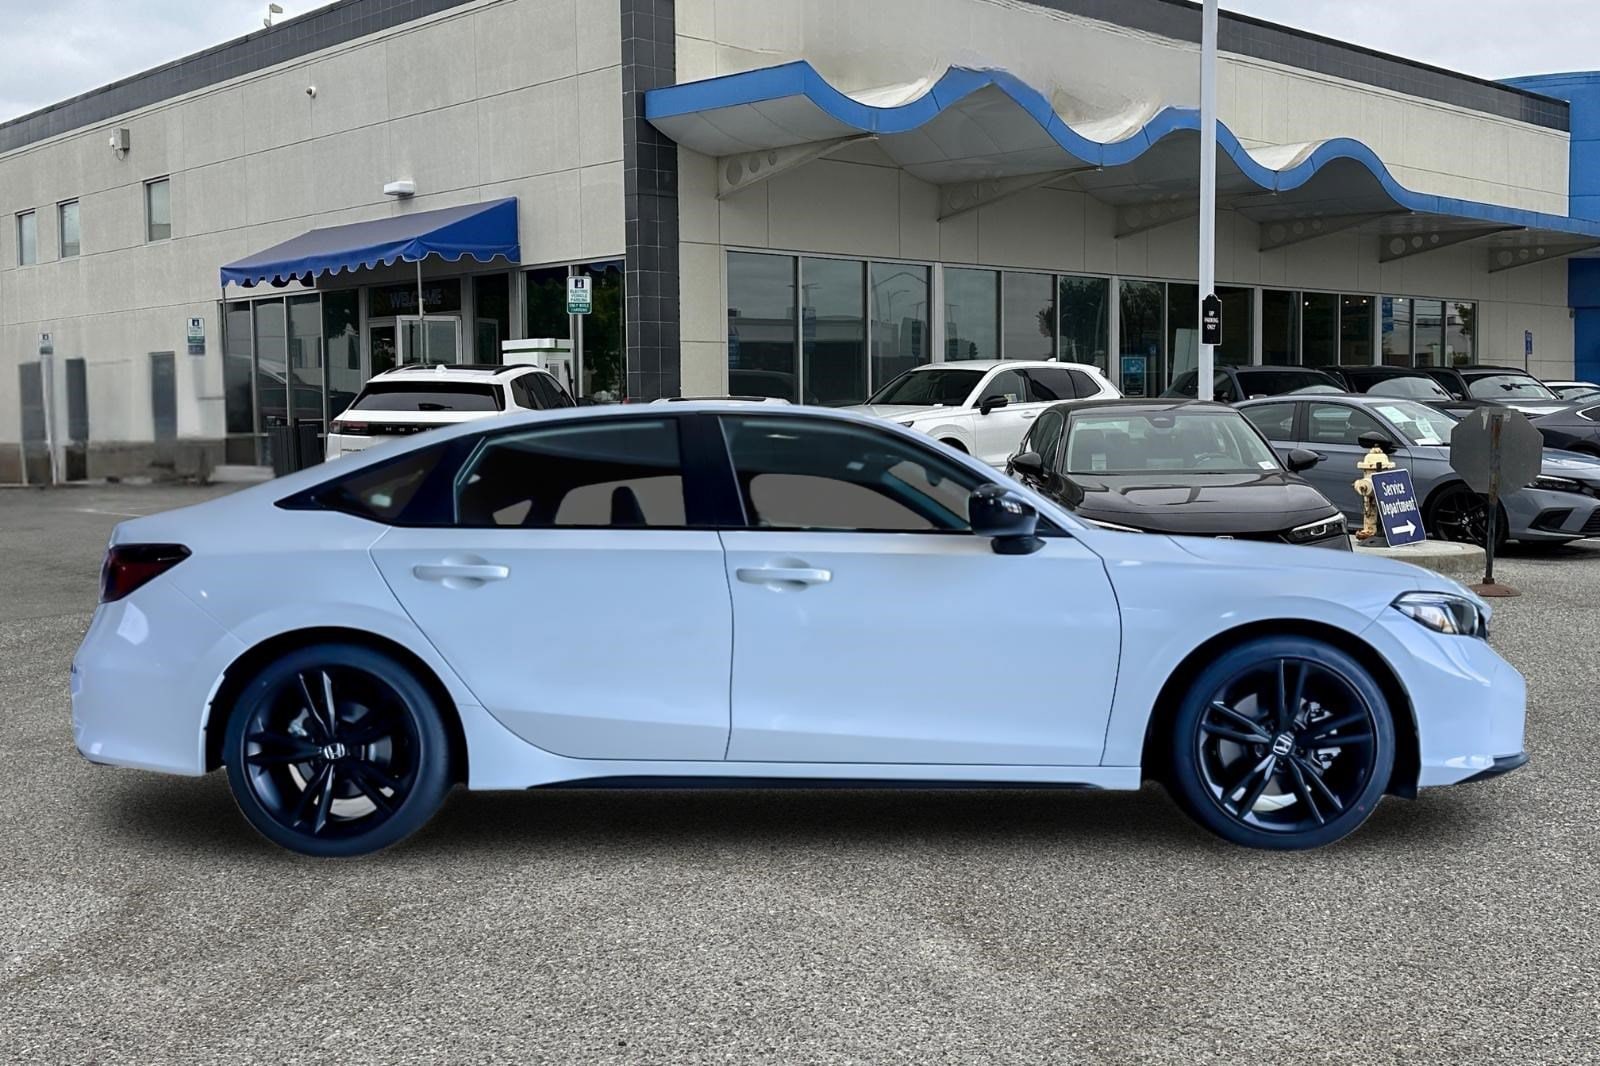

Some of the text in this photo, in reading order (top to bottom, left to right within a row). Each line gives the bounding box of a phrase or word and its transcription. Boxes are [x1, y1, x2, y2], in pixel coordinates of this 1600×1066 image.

[390, 288, 442, 309] WELCME
[1381, 480, 1406, 496] Service
[1380, 496, 1417, 518] Department
